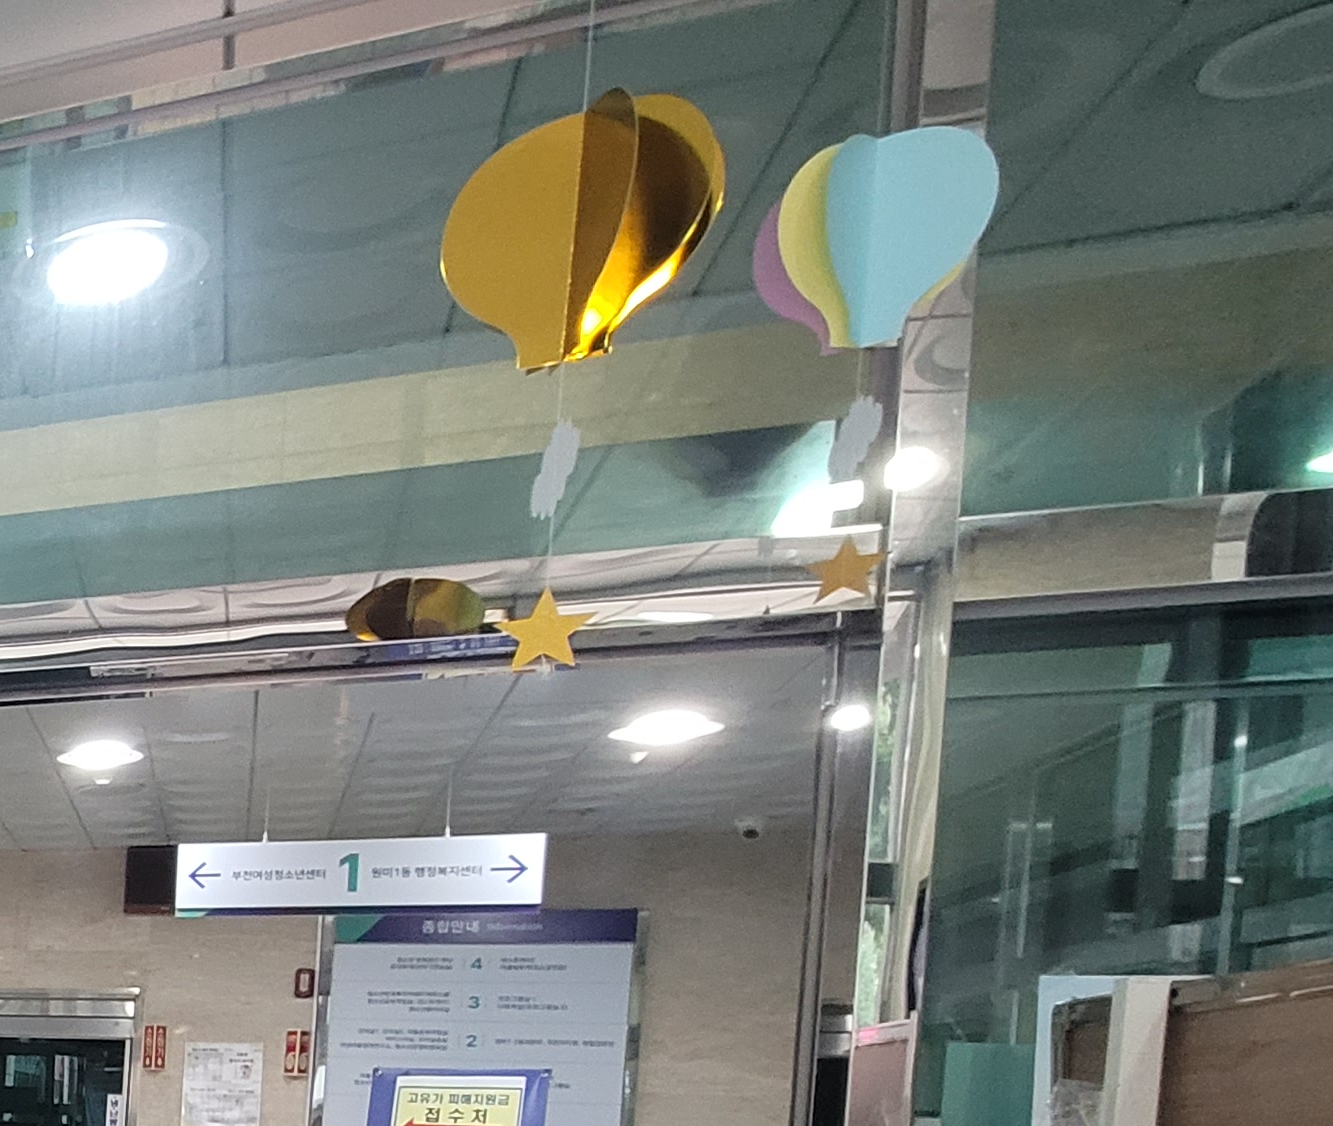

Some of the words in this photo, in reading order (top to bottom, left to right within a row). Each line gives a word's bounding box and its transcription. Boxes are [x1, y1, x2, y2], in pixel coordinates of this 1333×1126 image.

[232, 868, 327, 881] 부천여성청소년센터
[338, 852, 360, 893] 1
[371, 867, 411, 879] 원미1동
[414, 865, 483, 878] 행정복지센터
[470, 957, 482, 970] 4
[468, 996, 481, 1009] 3
[466, 1034, 478, 1047] 2
[407, 1092, 443, 1104] 고유가
[448, 1094, 510, 1106] 피해지원금
